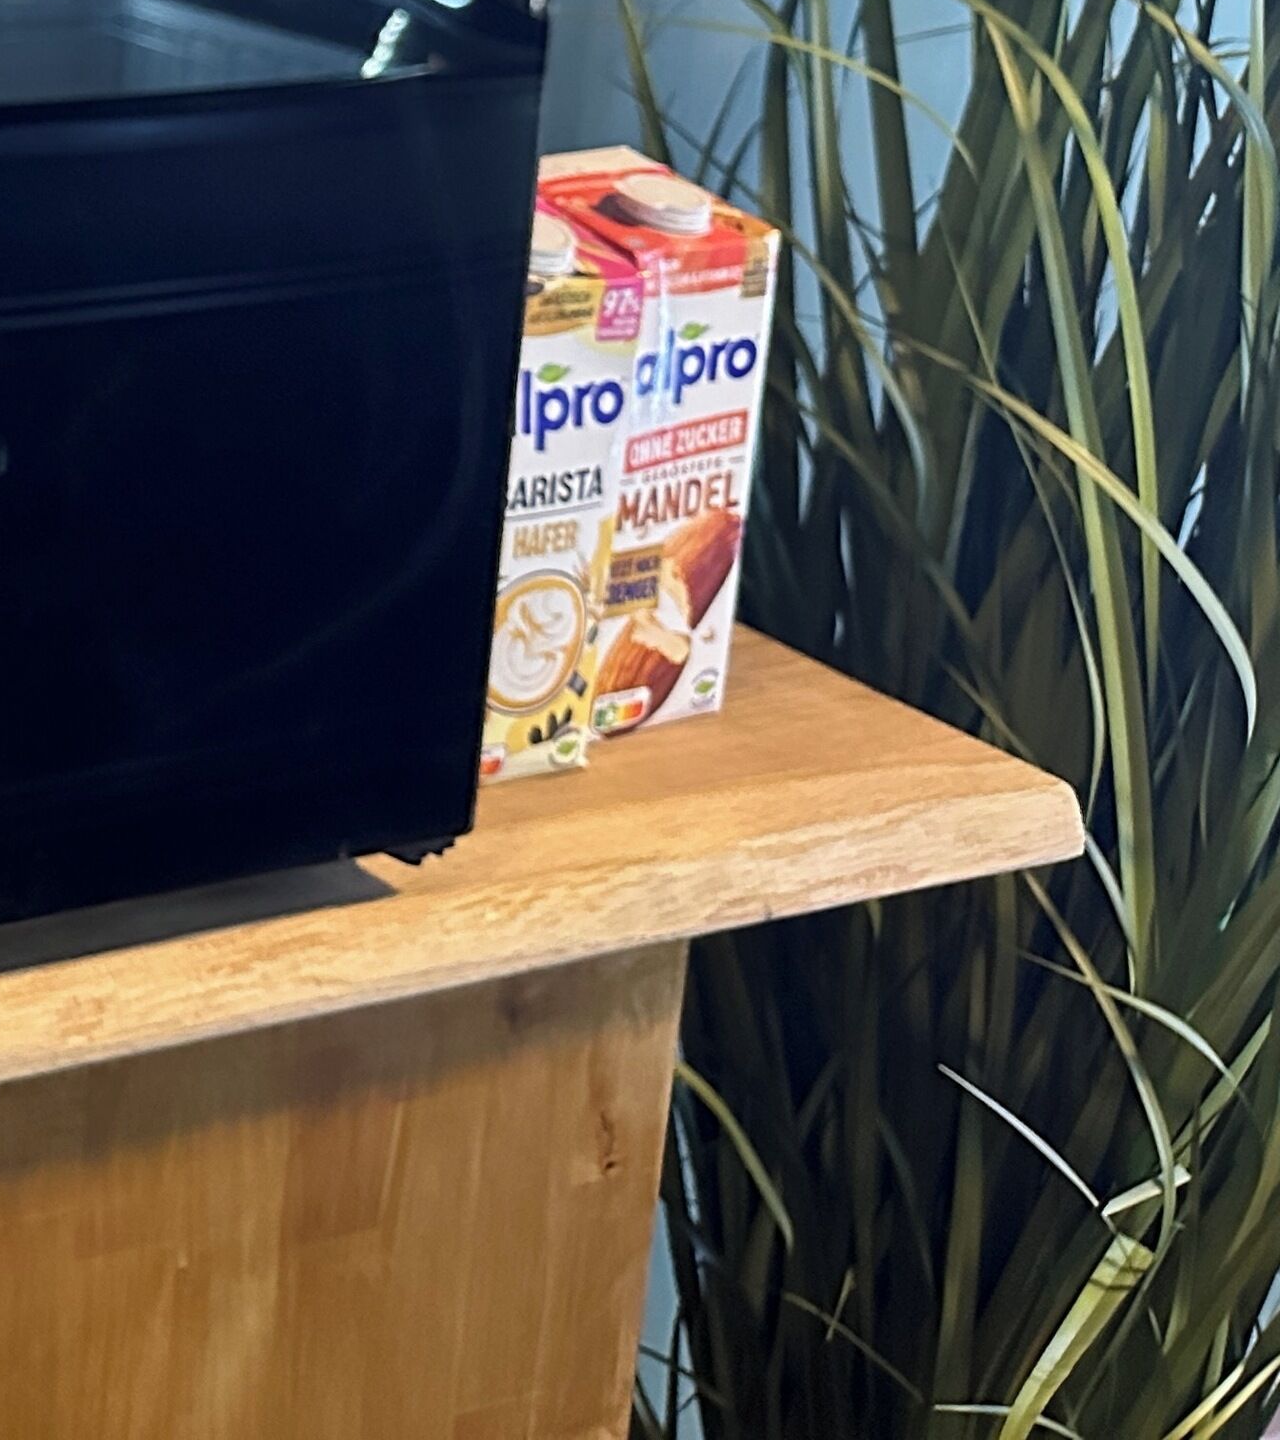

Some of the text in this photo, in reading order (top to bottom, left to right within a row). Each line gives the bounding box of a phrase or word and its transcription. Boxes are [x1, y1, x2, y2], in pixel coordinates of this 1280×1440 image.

[635, 327, 758, 405] alpro
[521, 370, 624, 451] lpro
[508, 465, 604, 511] ARISTA
[615, 470, 740, 532] MANDEL
